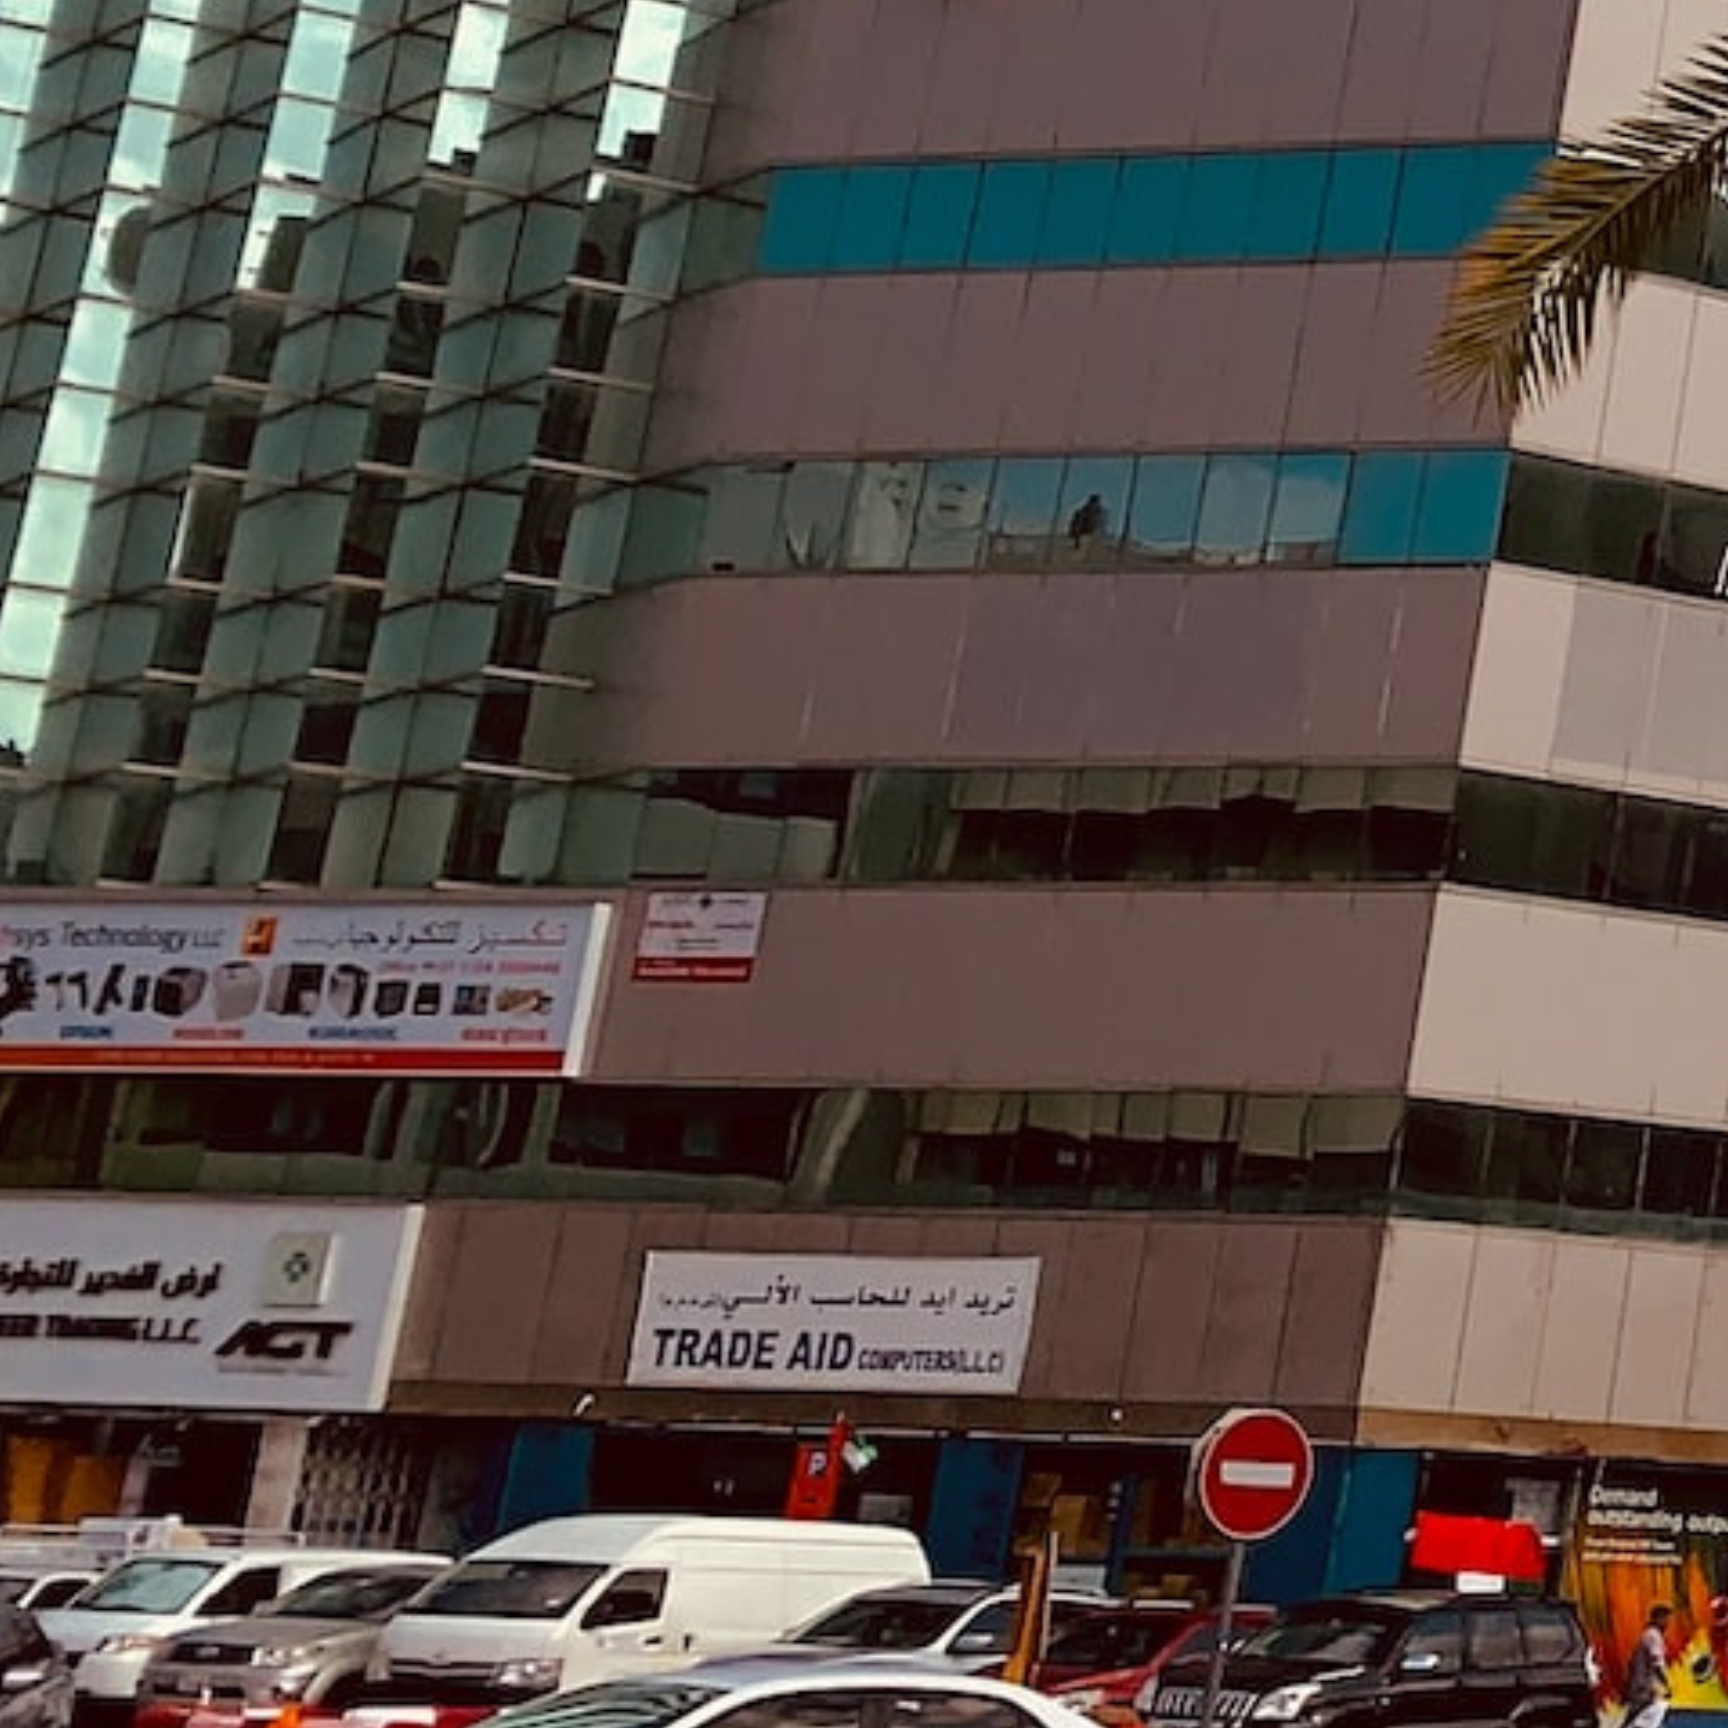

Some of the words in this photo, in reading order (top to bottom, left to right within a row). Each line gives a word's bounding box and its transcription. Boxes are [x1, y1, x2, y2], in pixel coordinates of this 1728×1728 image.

[0, 927, 49, 951] sys
[61, 922, 187, 954] Technology
[653, 1328, 779, 1371] TRADE
[787, 1330, 854, 1372] AID
